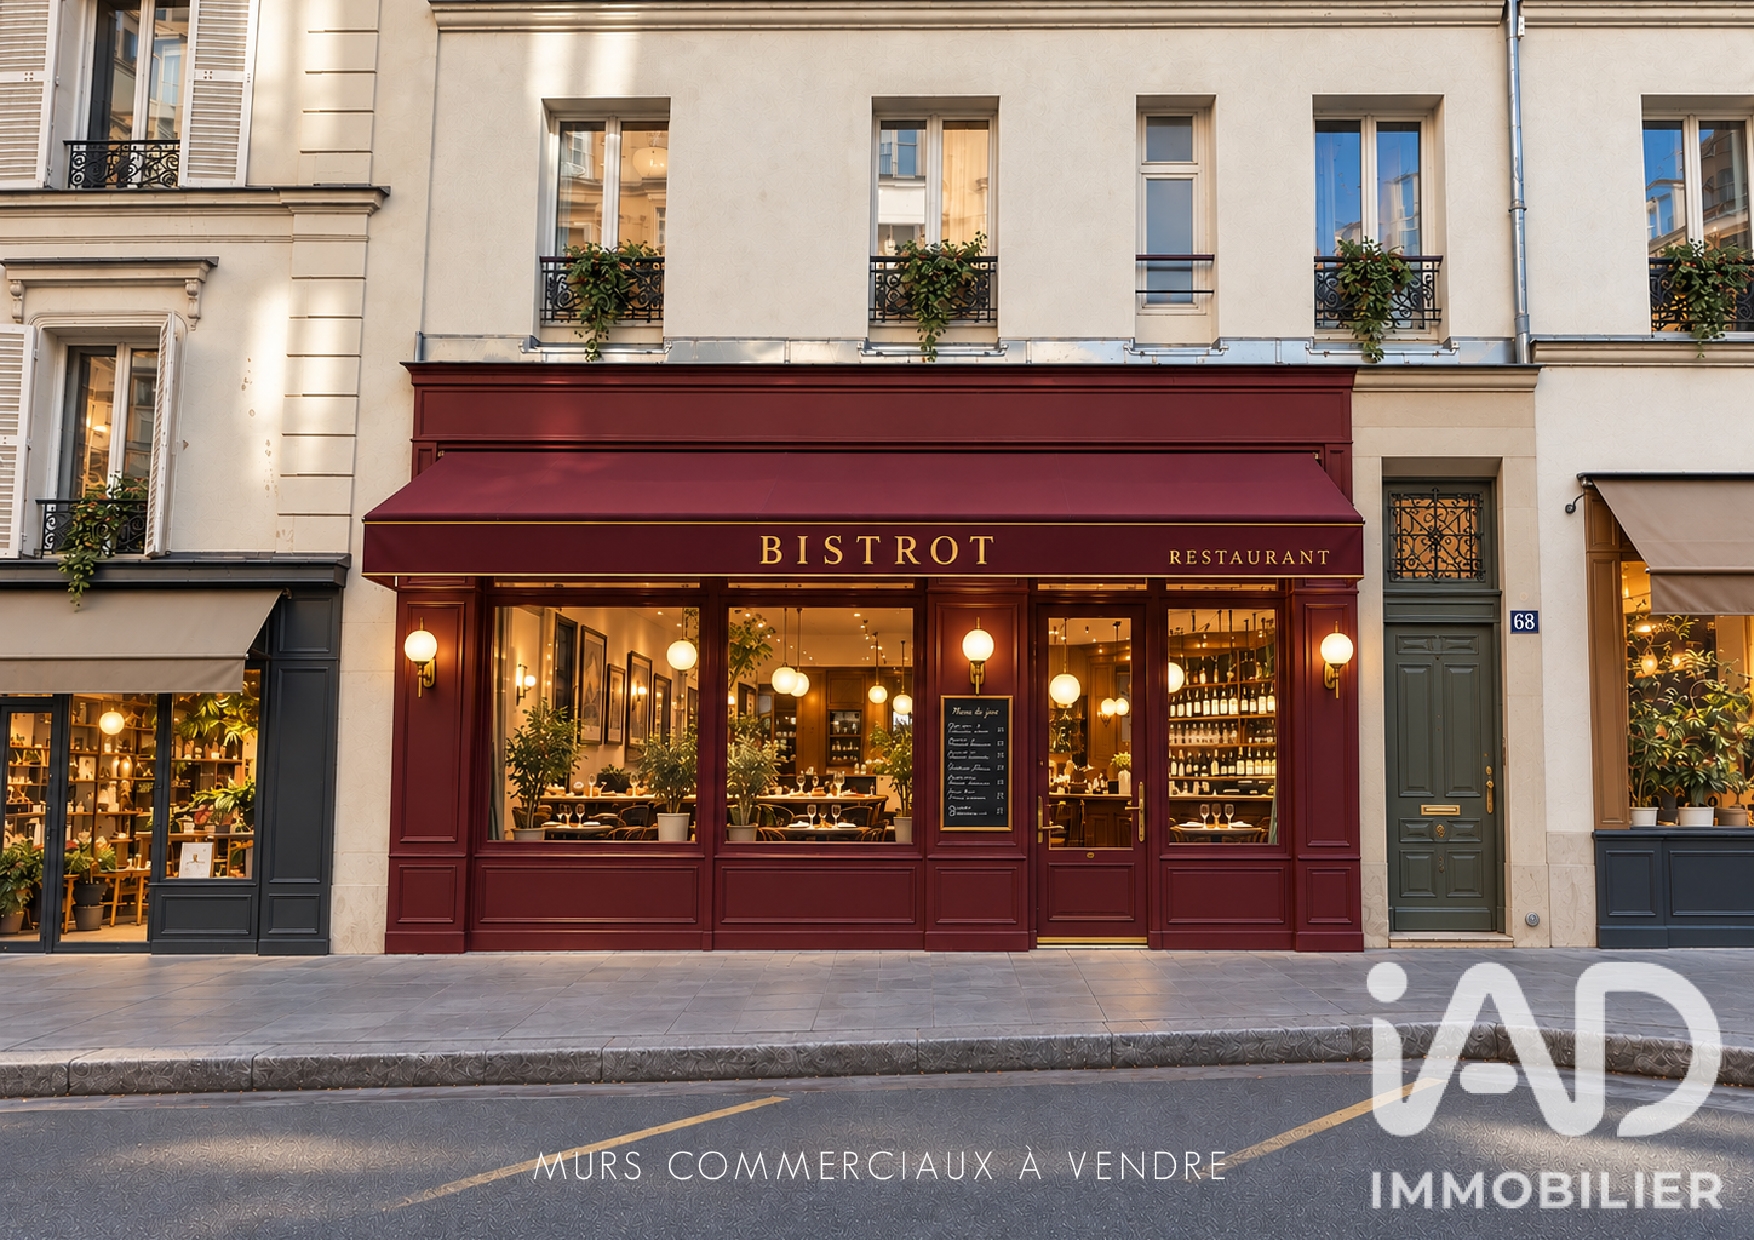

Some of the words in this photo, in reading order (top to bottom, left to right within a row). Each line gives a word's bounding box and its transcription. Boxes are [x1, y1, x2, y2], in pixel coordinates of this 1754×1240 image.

[760, 535, 994, 564] BISTROT
[1169, 550, 1331, 565] RESTAURANT
[1513, 613, 1536, 630] 68
